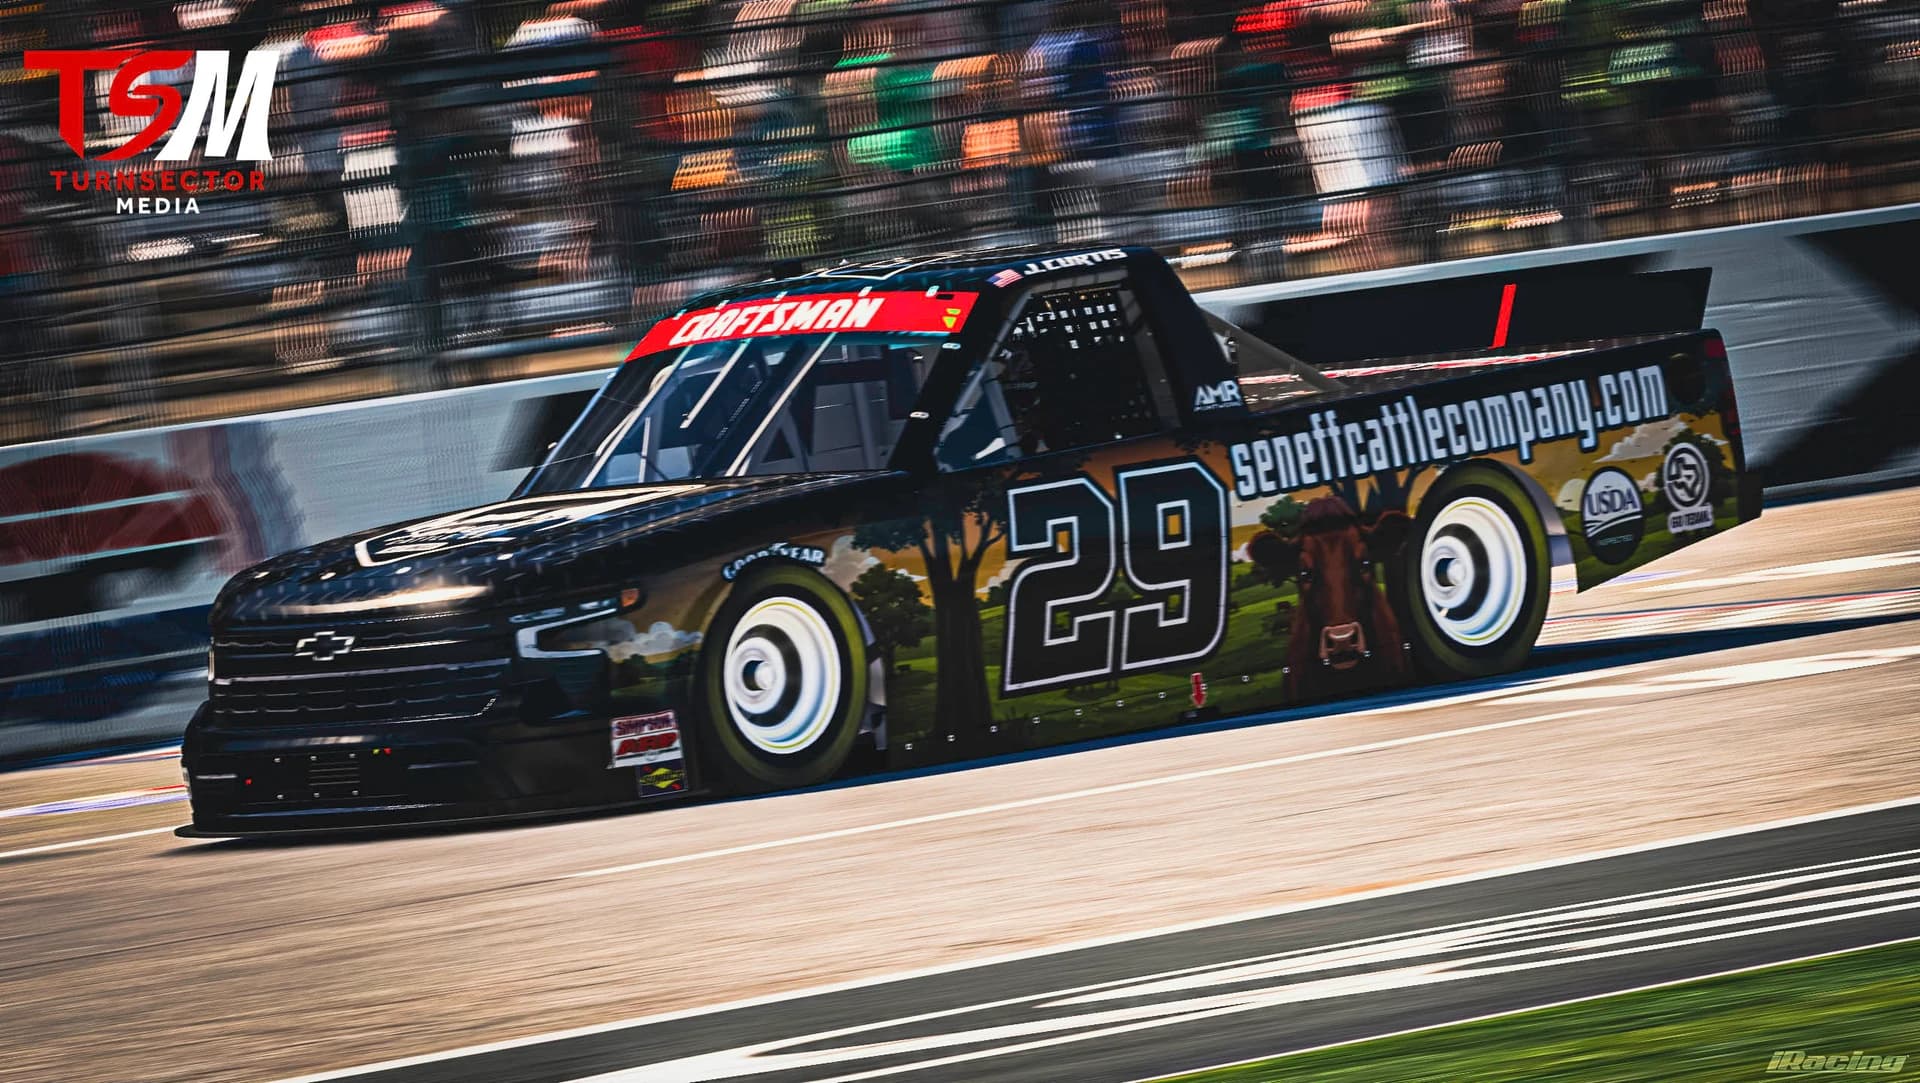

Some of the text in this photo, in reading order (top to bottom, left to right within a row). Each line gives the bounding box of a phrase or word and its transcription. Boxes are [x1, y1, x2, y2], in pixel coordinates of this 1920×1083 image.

[668, 298, 885, 346] CRAFTSMAN
[1194, 380, 1241, 406] AMR
[1231, 364, 1669, 497] seneffcattlecompany.com
[1585, 487, 1639, 517] USDA
[1003, 460, 1229, 692] 29
[615, 732, 678, 756] ARP
